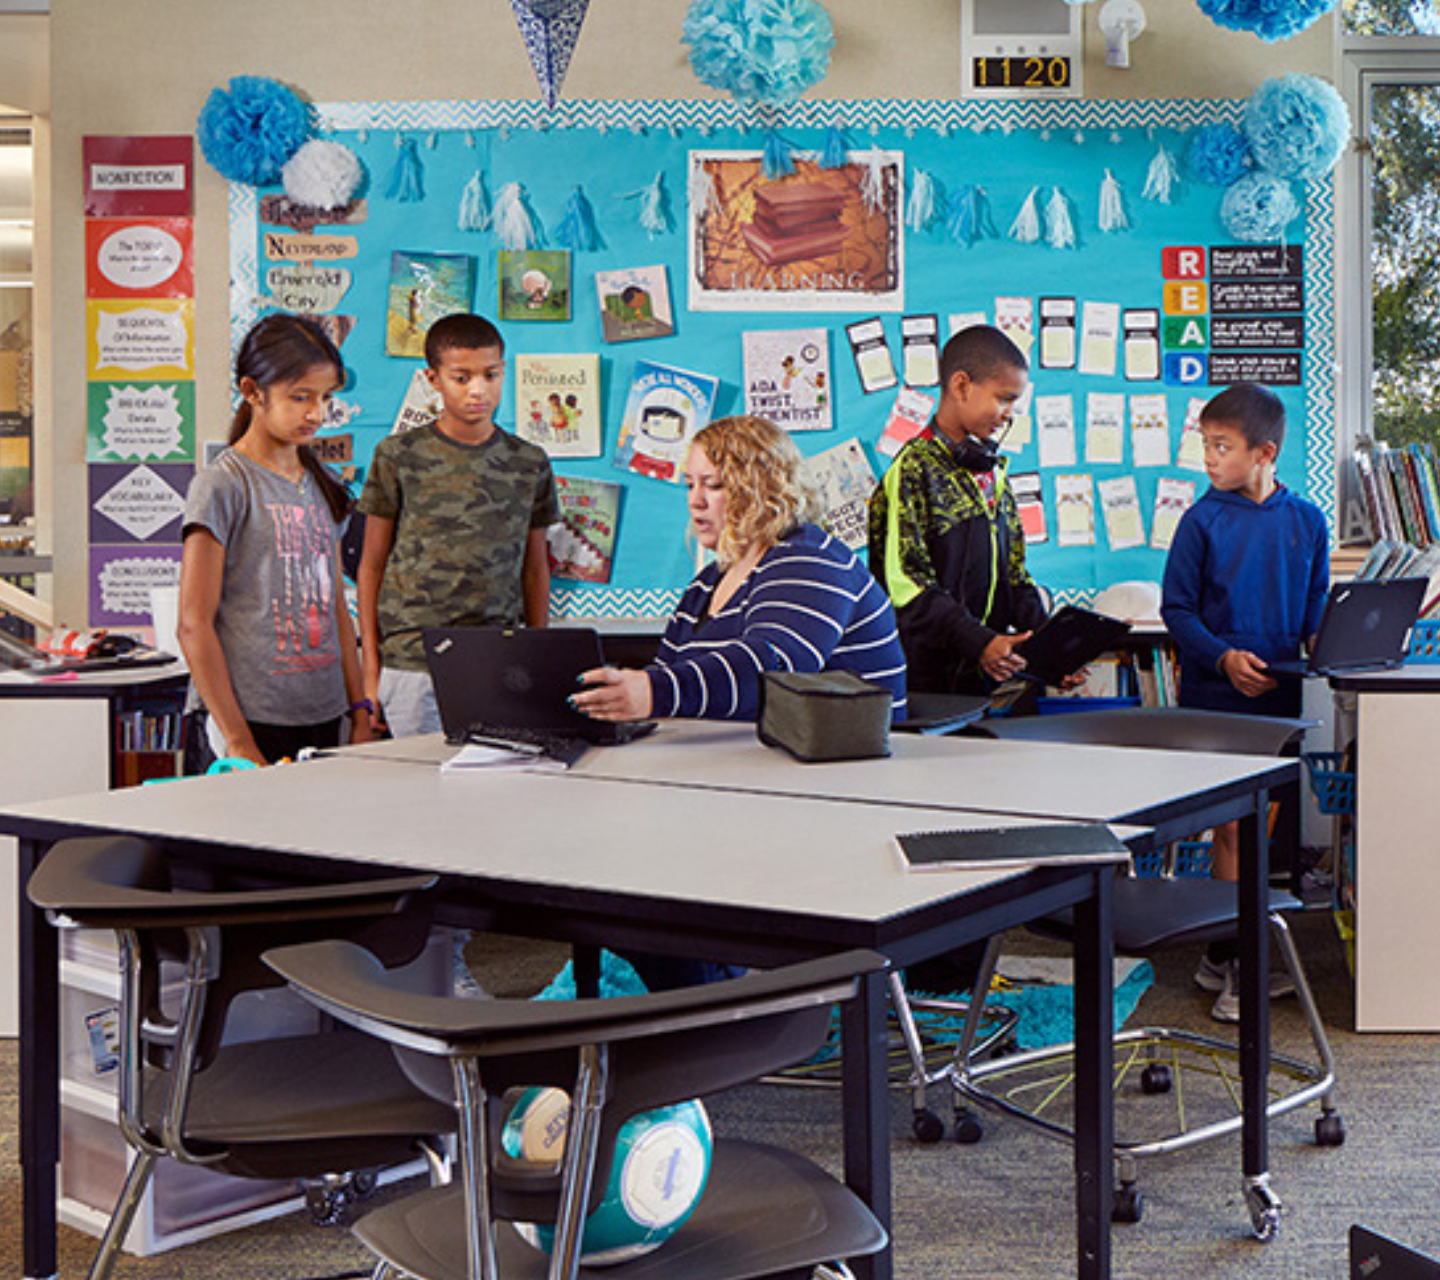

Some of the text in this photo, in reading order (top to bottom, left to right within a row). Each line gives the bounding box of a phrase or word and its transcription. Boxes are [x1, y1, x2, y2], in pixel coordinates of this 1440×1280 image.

[97, 170, 175, 184] NONFICTION
[1179, 251, 1200, 276] R
[269, 270, 342, 287] Emerald
[730, 271, 866, 289] LEARNING
[284, 295, 317, 308] City
[1180, 286, 1199, 311] E
[1178, 320, 1205, 345] A
[1180, 356, 1203, 382] D
[750, 379, 777, 394] ADA
[110, 492, 174, 500] VOCABULARY
